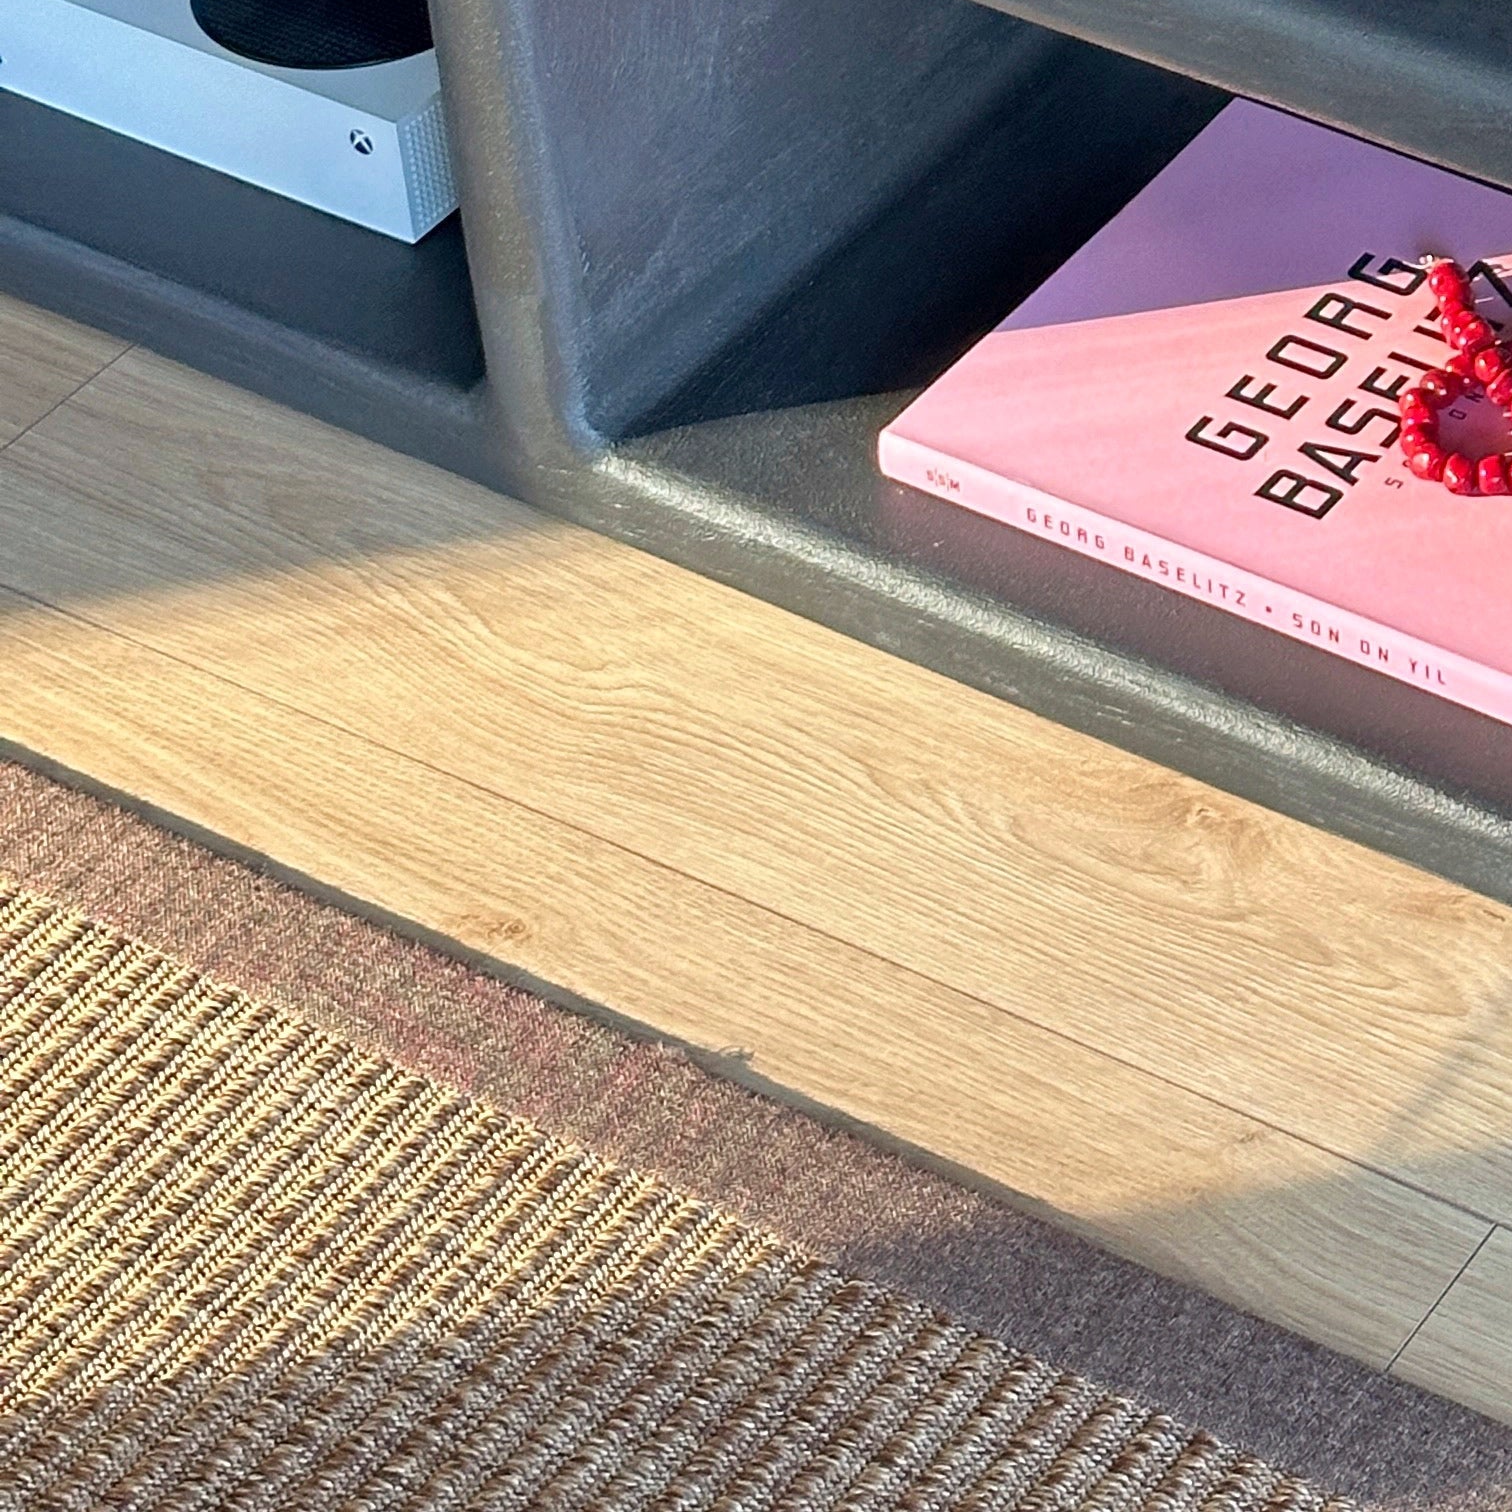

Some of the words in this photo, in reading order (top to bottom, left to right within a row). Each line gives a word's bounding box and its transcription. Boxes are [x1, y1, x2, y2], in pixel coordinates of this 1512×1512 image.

[1186, 252, 1429, 460] GEORG
[1027, 508, 1105, 549] GEORG
[1125, 546, 1246, 607] BASELITZ
[1293, 613, 1340, 643] SON
[1360, 639, 1389, 662] ON
[1410, 658, 1446, 685] YIL
